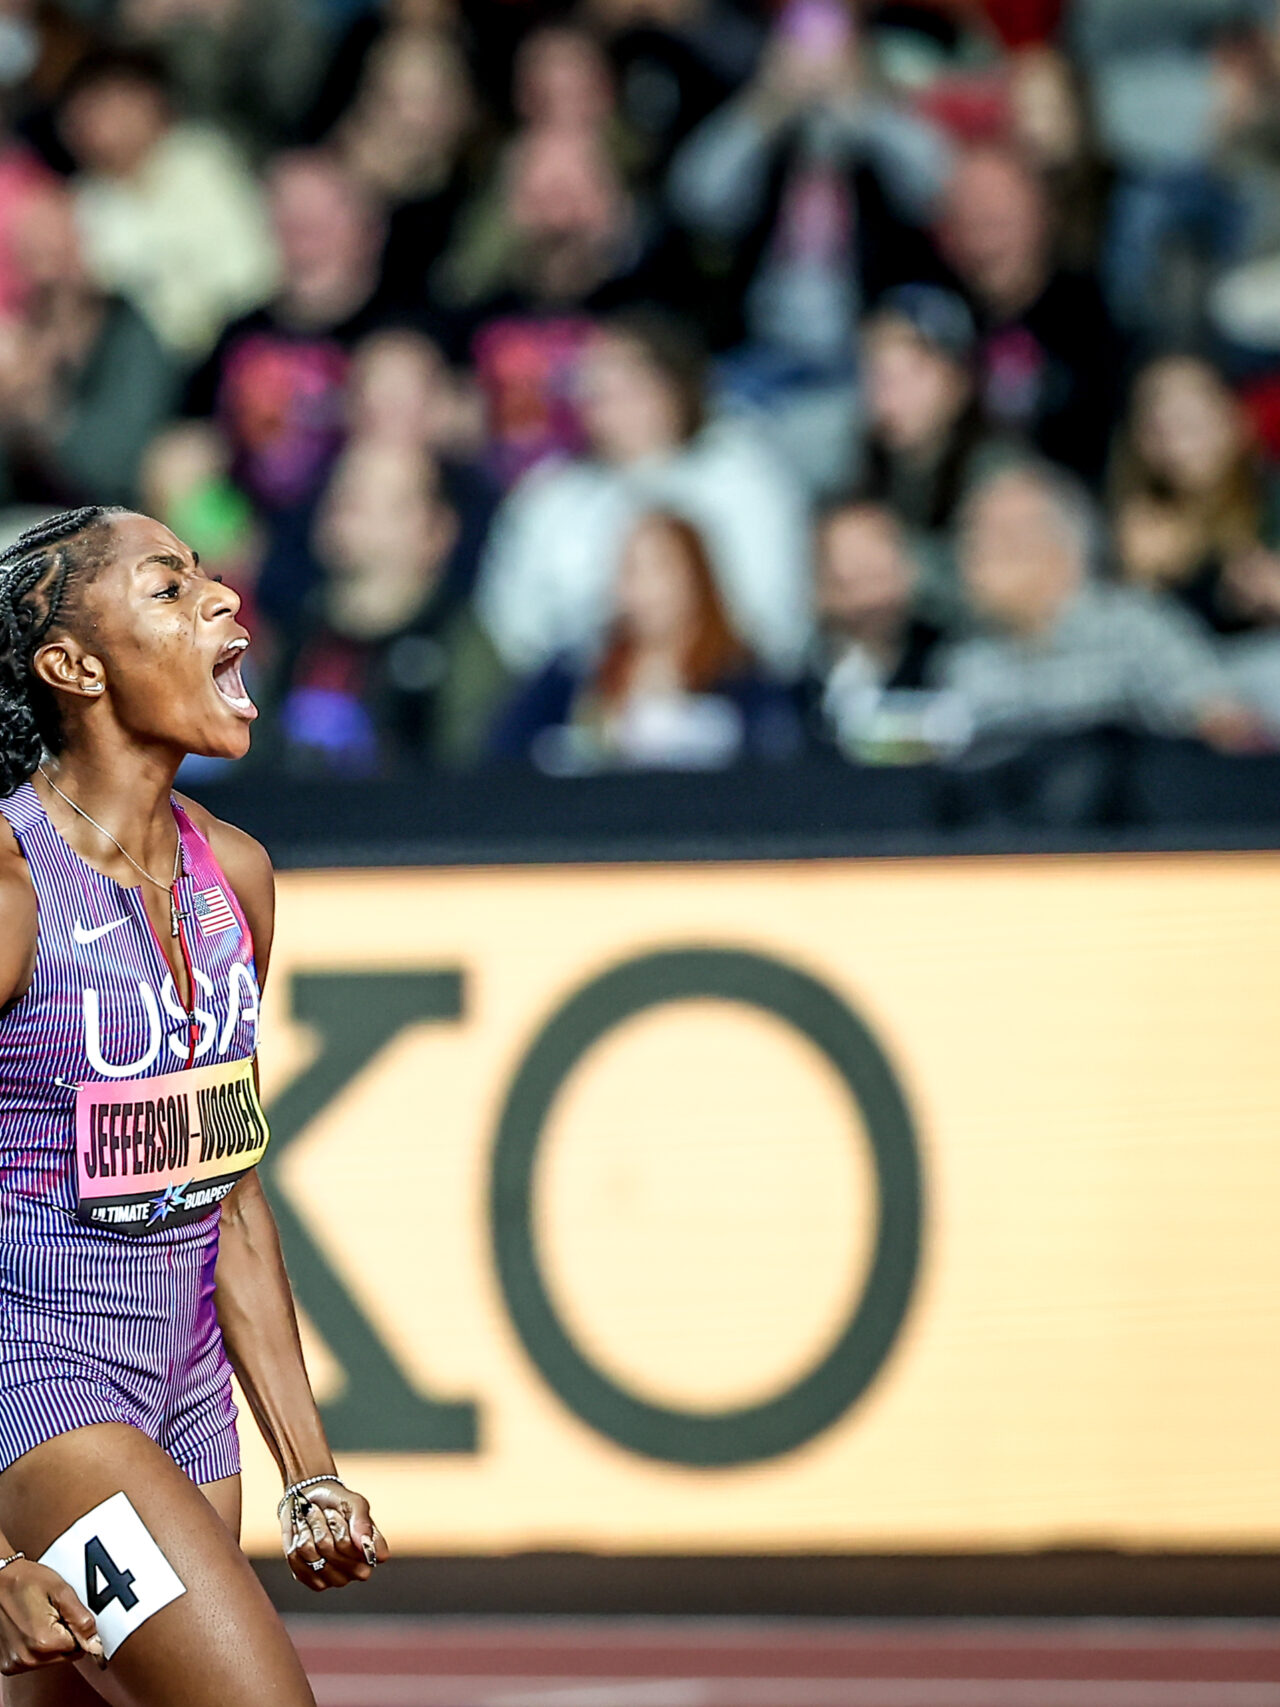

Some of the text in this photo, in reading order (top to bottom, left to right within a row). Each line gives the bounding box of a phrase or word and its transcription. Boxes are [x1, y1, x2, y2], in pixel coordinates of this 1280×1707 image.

[82, 961, 261, 1077] USA
[83, 1077, 265, 1179] JEFFERSON-WOODEN
[91, 1181, 235, 1223] ULTIMATE BUDAPEST
[84, 1535, 139, 1615] 4
